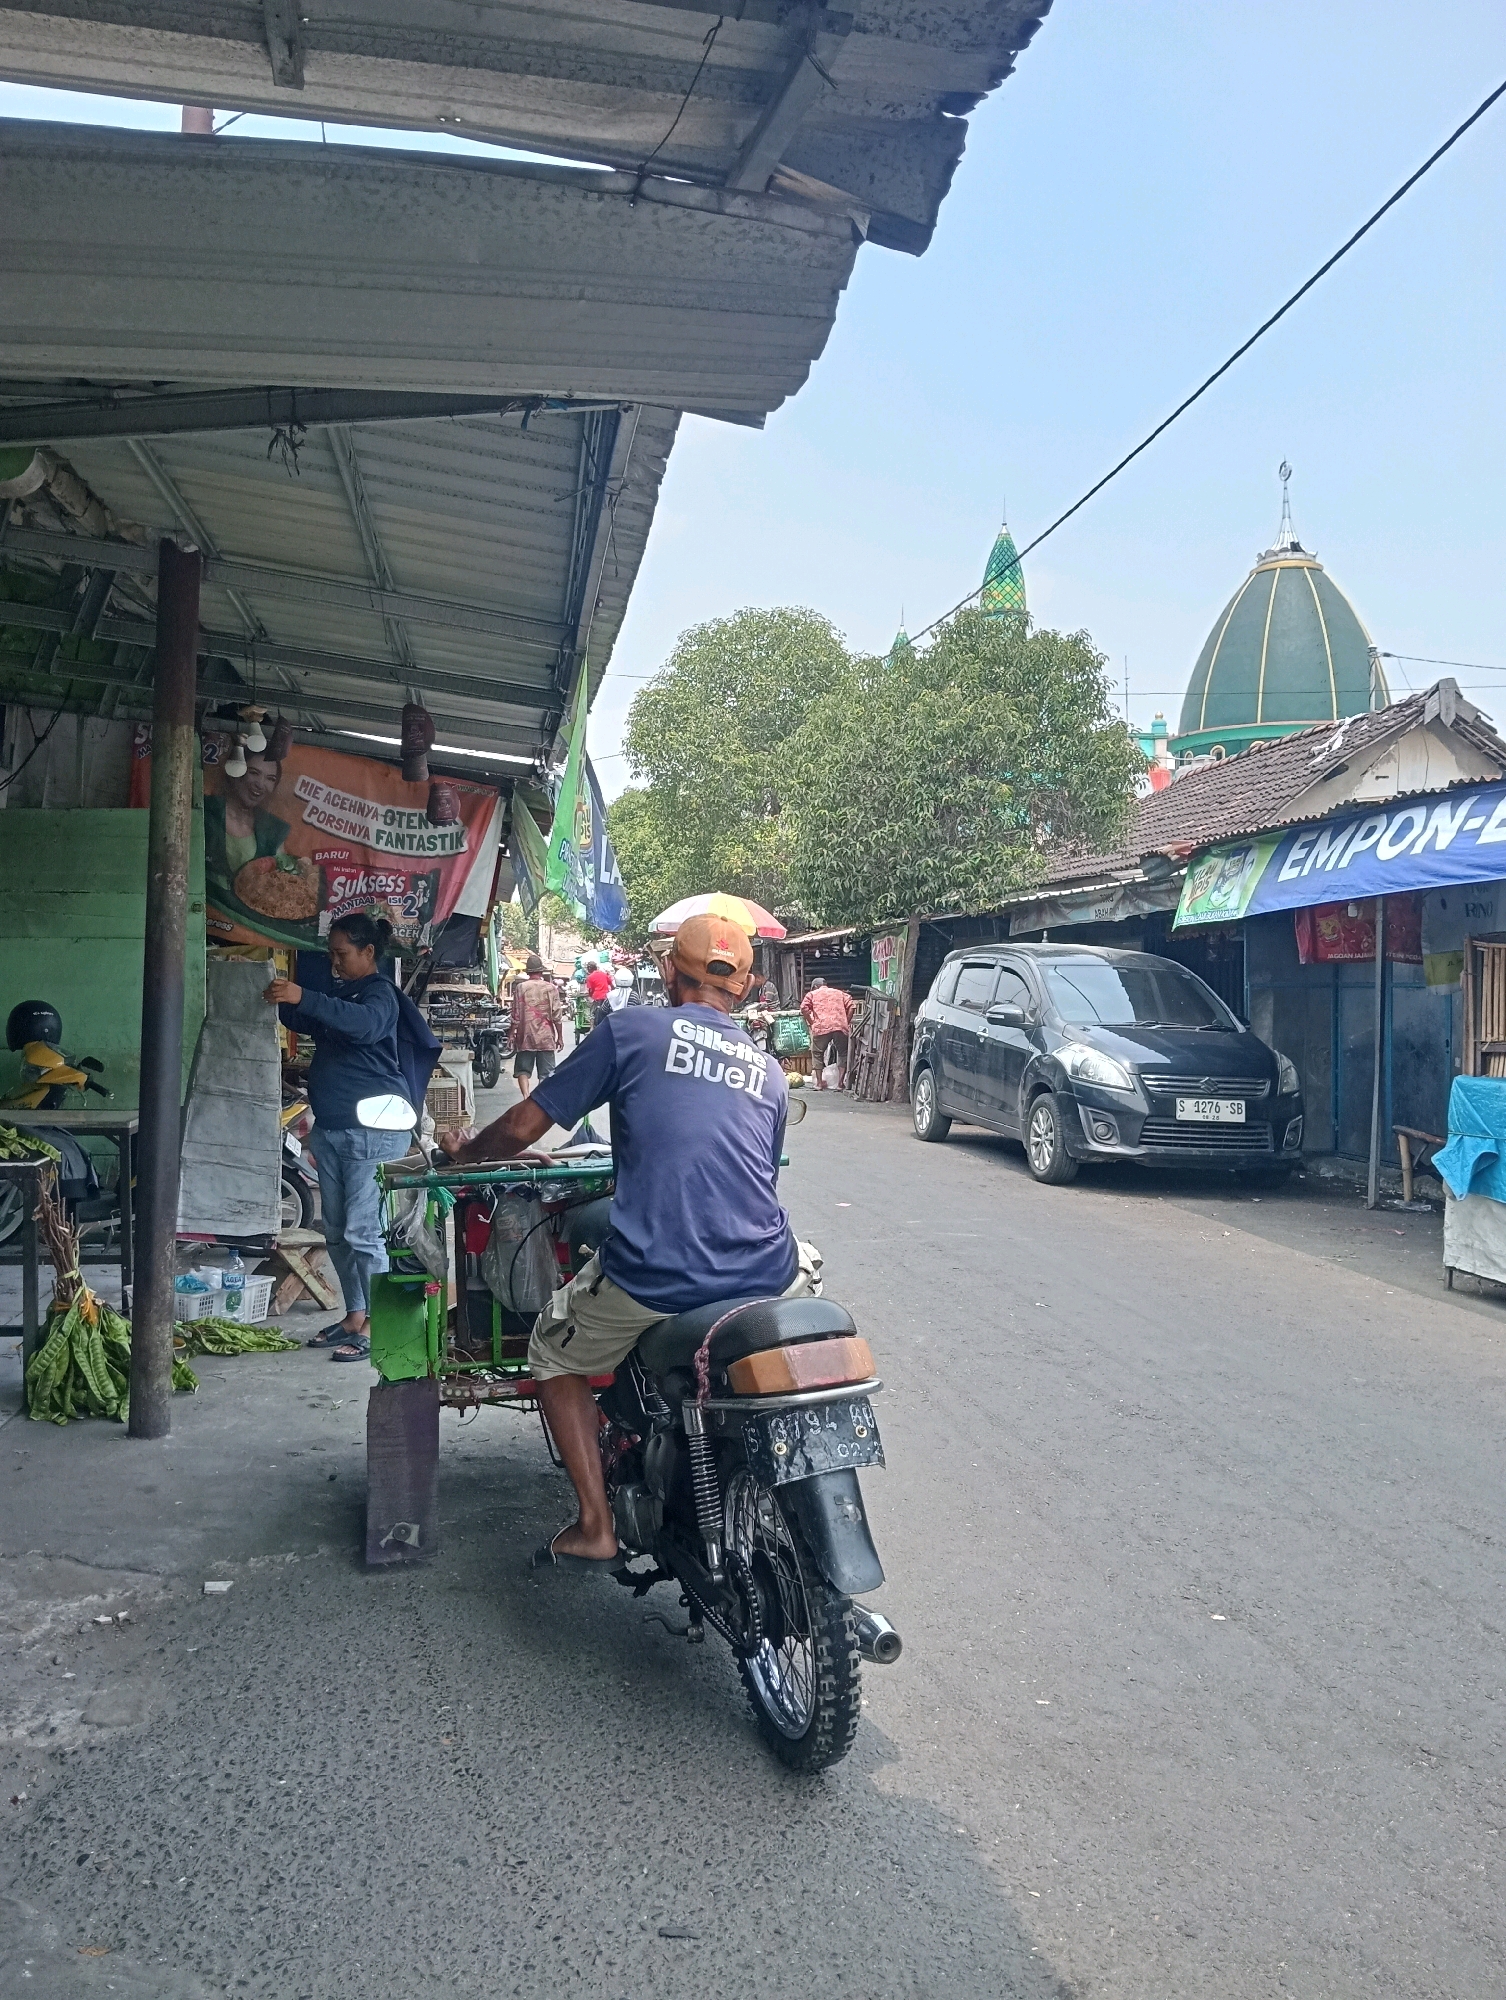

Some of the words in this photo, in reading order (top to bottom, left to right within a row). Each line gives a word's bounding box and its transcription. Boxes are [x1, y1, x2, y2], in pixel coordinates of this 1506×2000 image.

[299, 779, 324, 798] MIE
[323, 792, 379, 821] ACEHNYA
[383, 808, 459, 831] OTEN
[307, 805, 371, 841] PORSINYA
[375, 828, 466, 852] FANTASTIK
[315, 850, 350, 860] BARU!
[388, 896, 402, 905] ISI
[401, 894, 419, 918] 2
[392, 928, 420, 938] ACEH
[672, 1018, 768, 1069] Gillette
[1178, 1100, 1185, 1112] S
[1194, 1101, 1220, 1113] 1276
[1229, 1102, 1244, 1115] SB
